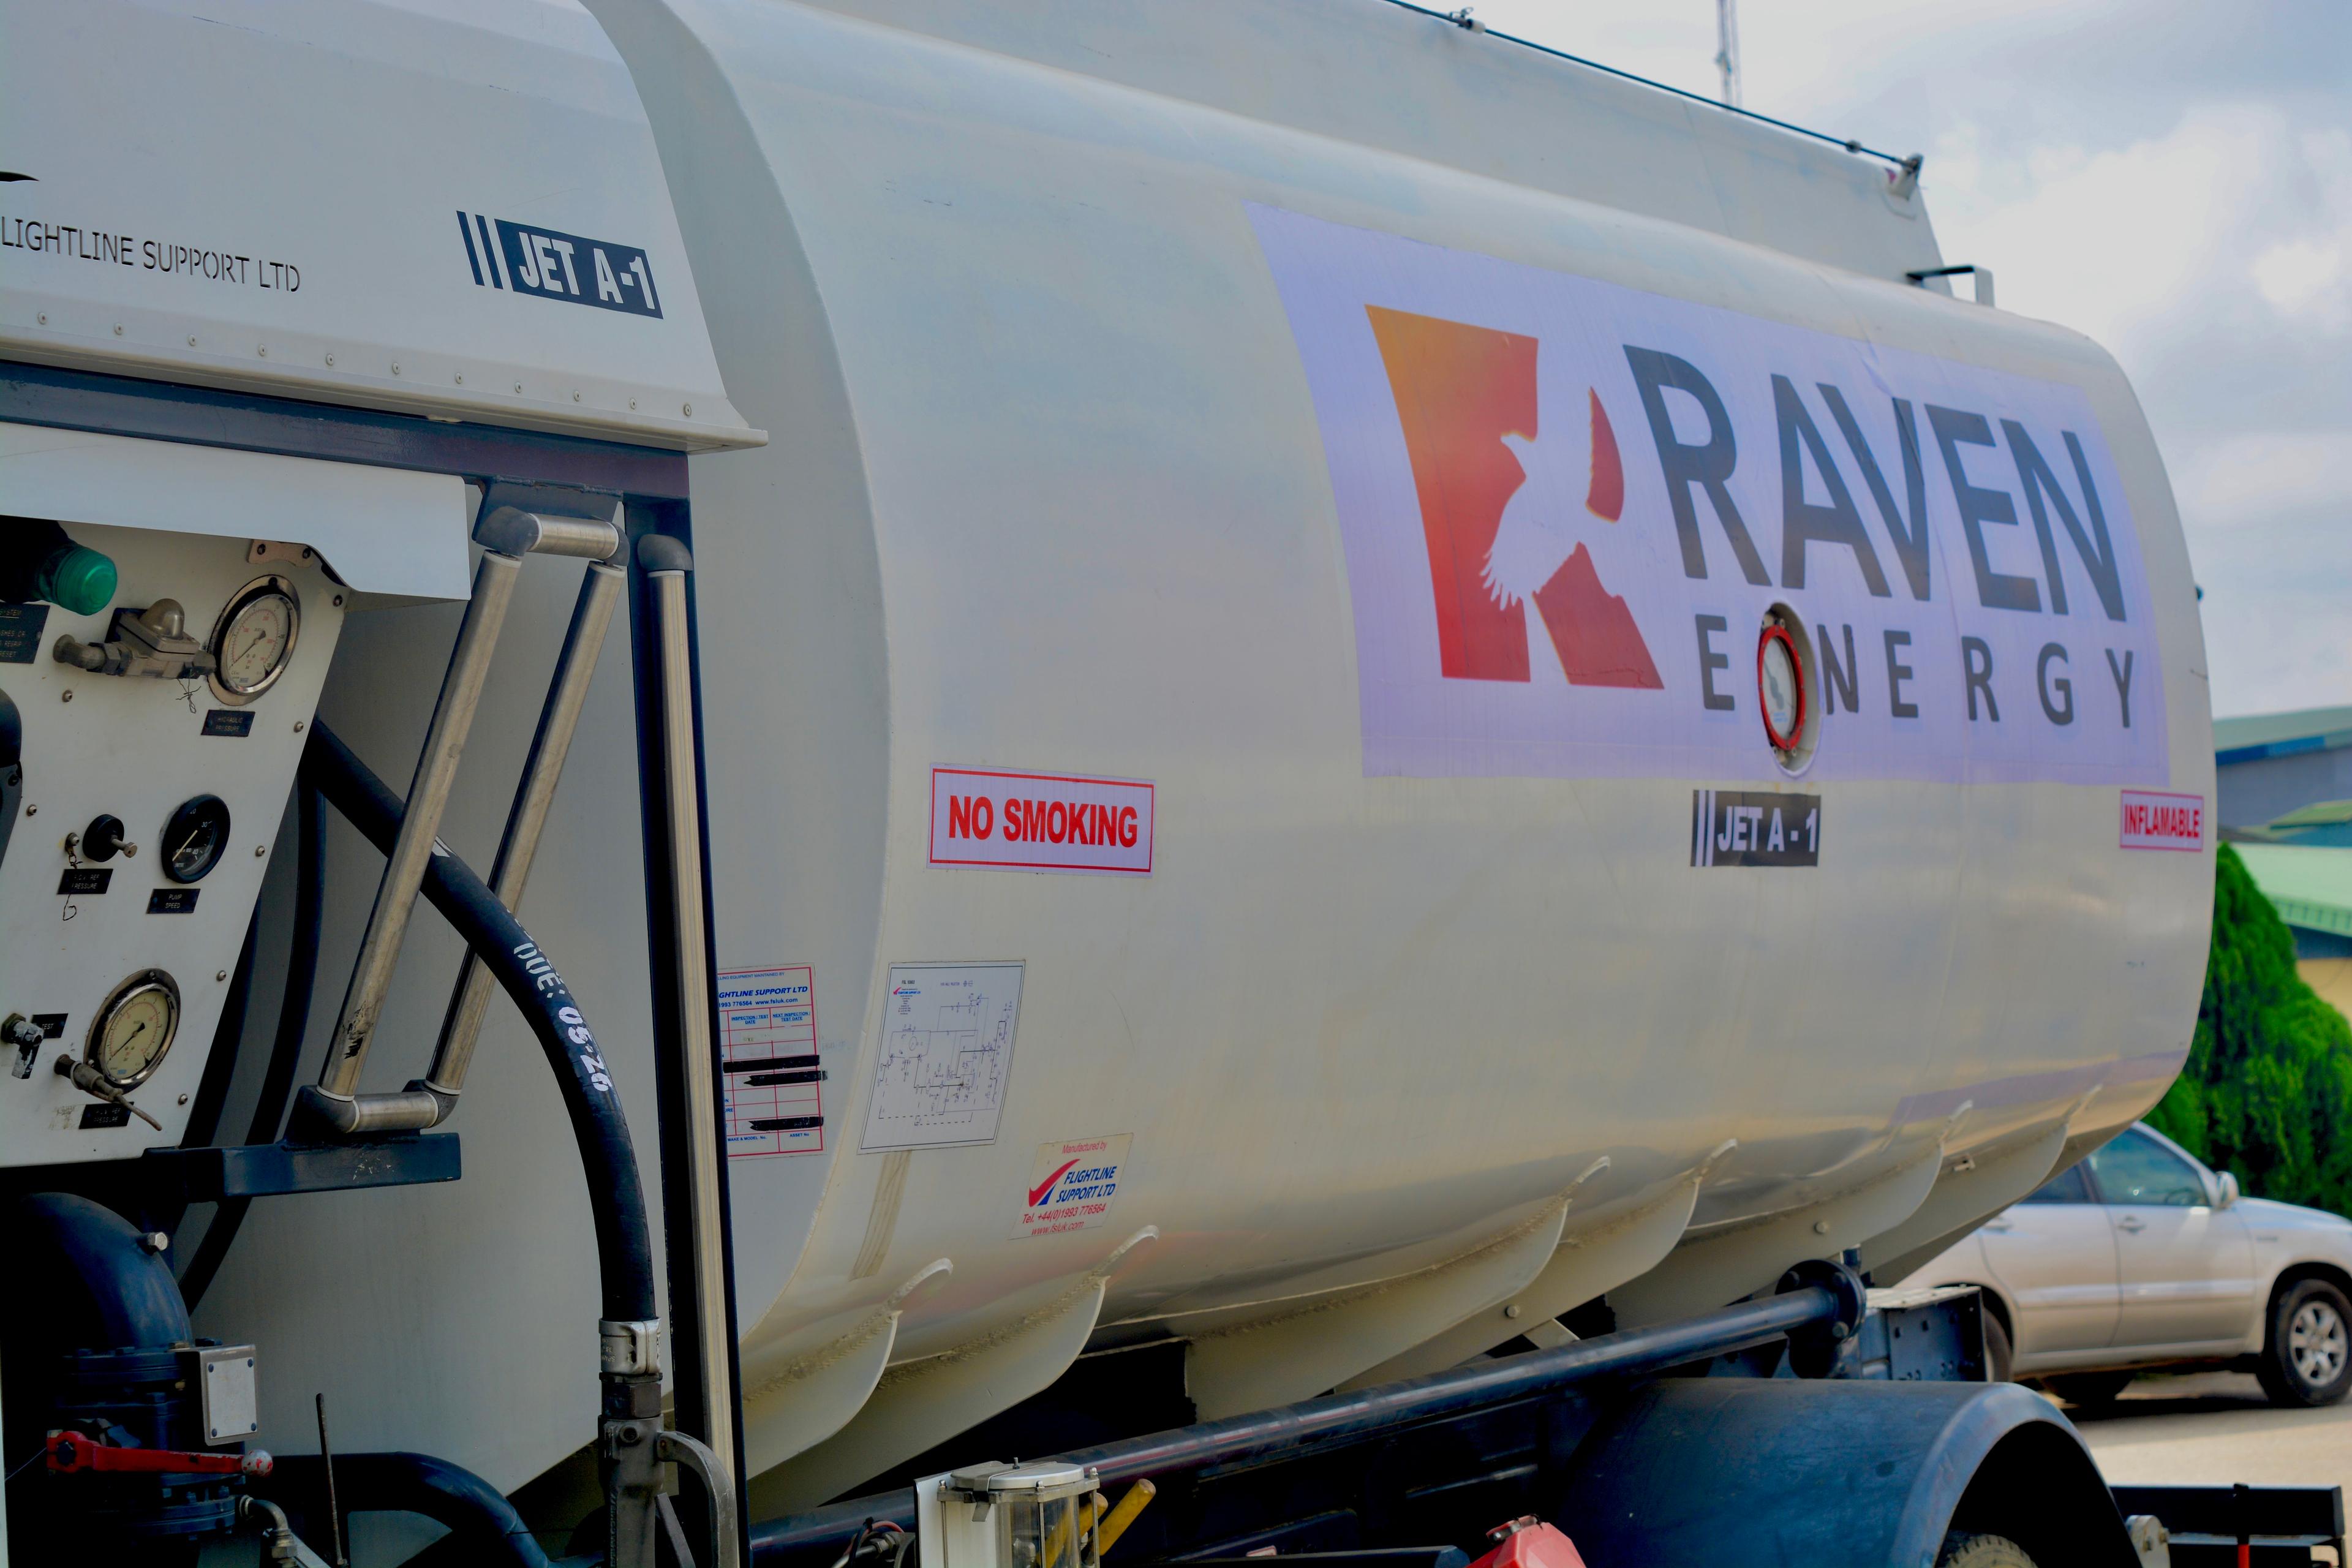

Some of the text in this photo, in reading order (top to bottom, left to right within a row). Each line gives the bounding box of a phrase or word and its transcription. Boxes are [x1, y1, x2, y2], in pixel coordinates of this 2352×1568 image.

[1, 216, 301, 292] LIGHTLINE SUPPORT LTD
[519, 232, 655, 309] JET A-1
[1623, 344, 2126, 622] RAVEN
[1695, 613, 2134, 728] ENERGY
[949, 795, 1137, 848] NO SMOKING
[1717, 806, 1763, 851] JET
[755, 987, 791, 996] SUPPORT
[1062, 1141, 1107, 1154] Manufactured by
[1064, 1166, 1117, 1185] FLIGHTLINE
[1056, 1183, 1116, 1203] SUPPORT LTD
[1022, 1203, 1107, 1224] Tel. +44(0)1993 776564
[1031, 1221, 1084, 1235] www.fsluk.com
